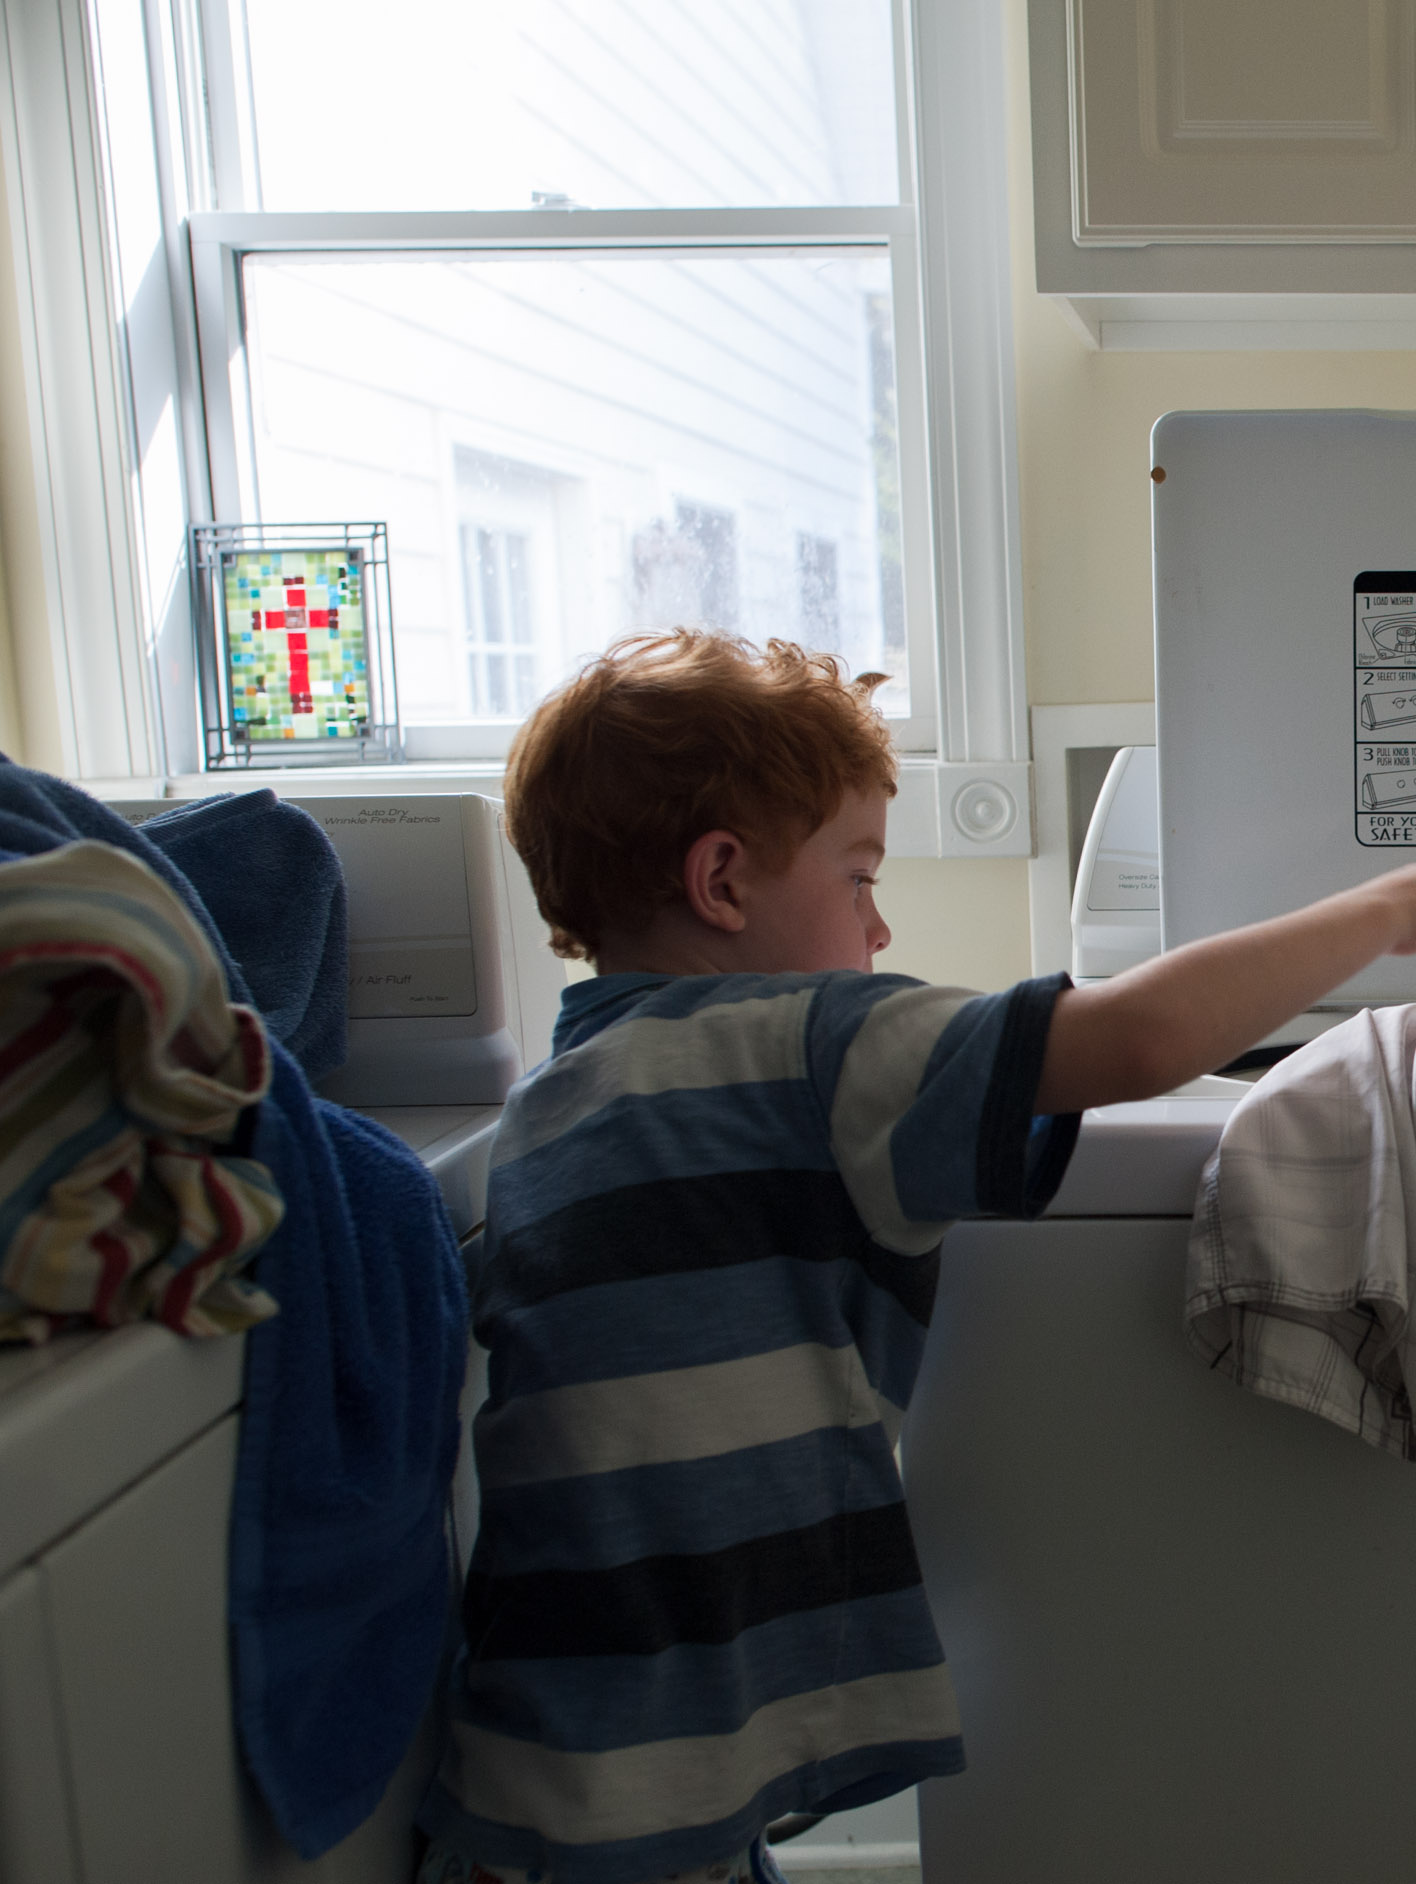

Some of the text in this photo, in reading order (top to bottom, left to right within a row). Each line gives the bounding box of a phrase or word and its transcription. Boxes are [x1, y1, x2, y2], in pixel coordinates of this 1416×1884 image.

[1364, 596, 1370, 610] 1
[1373, 596, 1414, 606] LOAD WASHER
[1363, 672, 1374, 685] 2
[1377, 672, 1396, 681] SELECT
[1363, 748, 1374, 761] 3
[1377, 748, 1390, 756] PULL
[1393, 748, 1409, 756] KNOB
[1377, 757, 1392, 766] PUSH
[1394, 757, 1410, 766] KNOB
[388, 808, 408, 817] Dry
[399, 815, 441, 824] Fabrics
[1370, 816, 1394, 826] FOR
[366, 976, 384, 984] Air
[386, 975, 412, 984] Fluff
